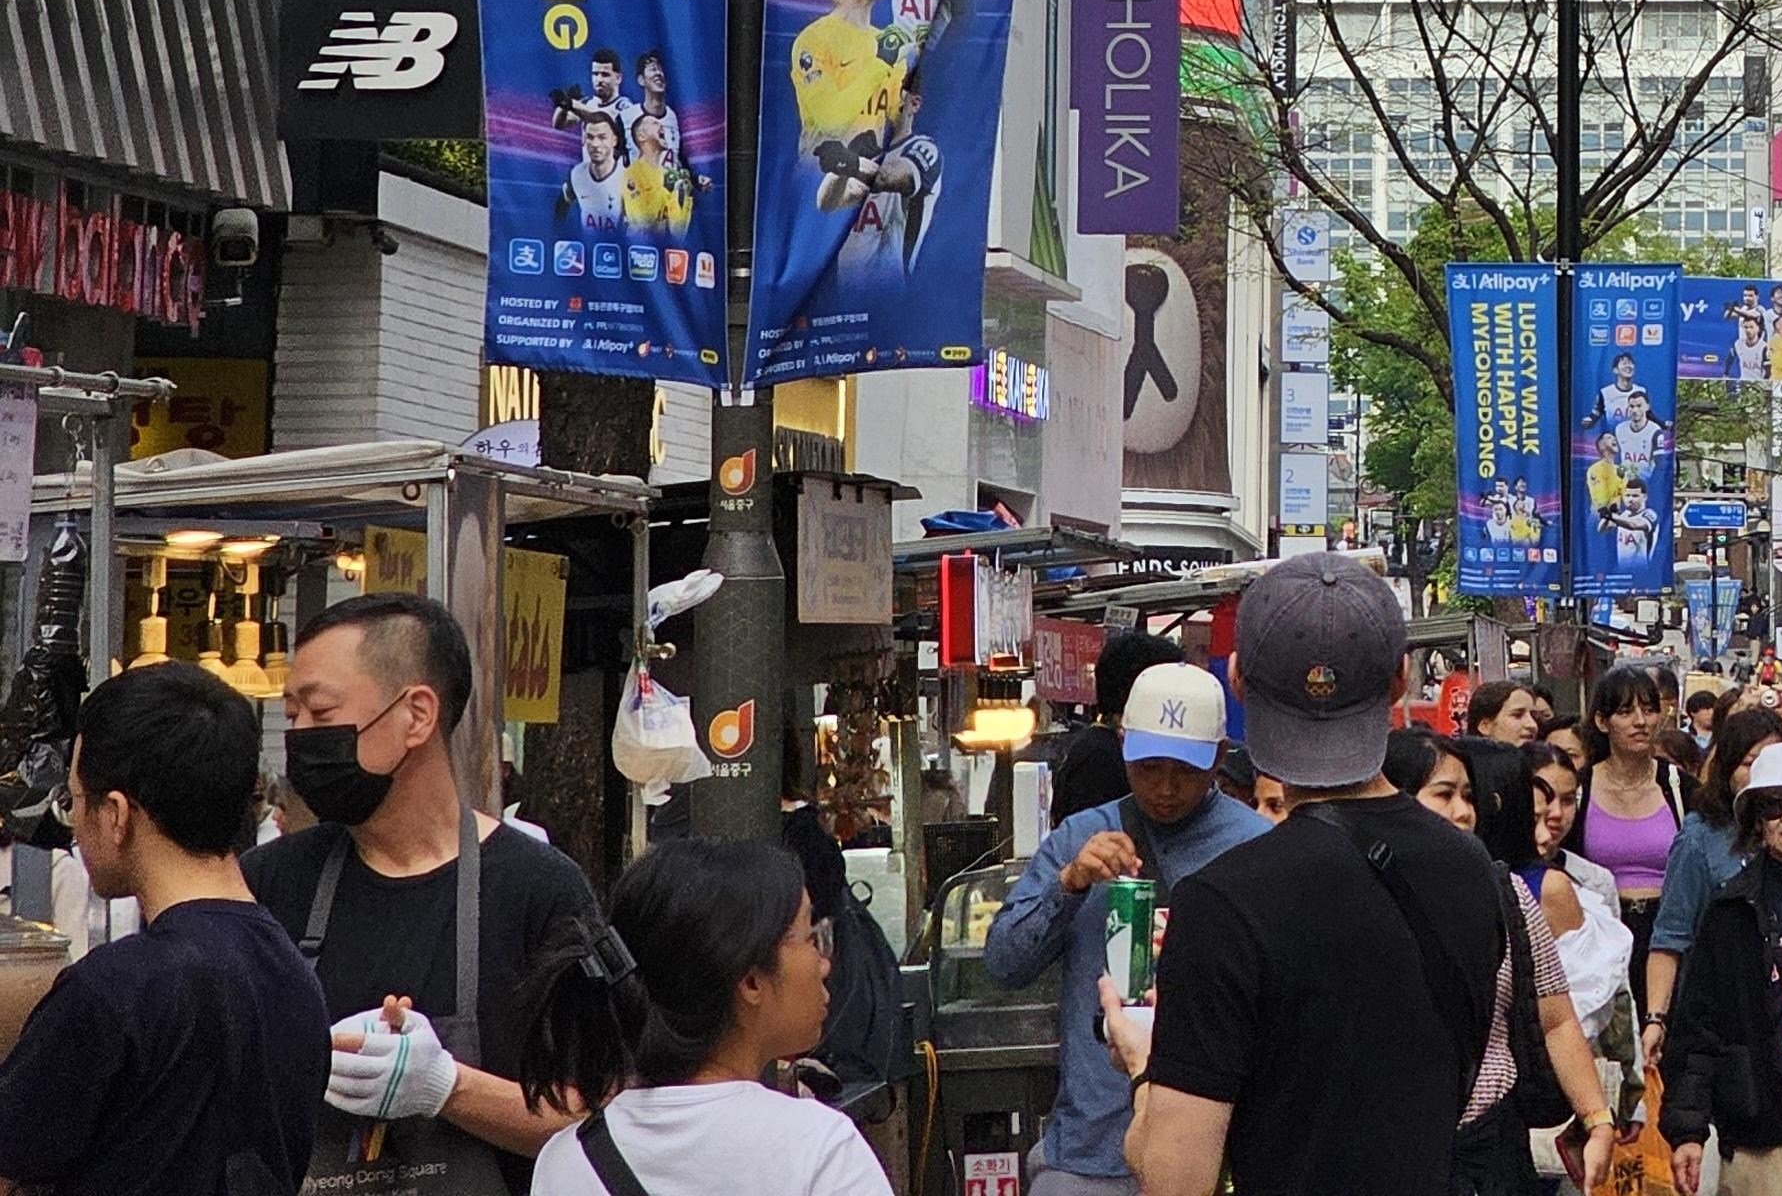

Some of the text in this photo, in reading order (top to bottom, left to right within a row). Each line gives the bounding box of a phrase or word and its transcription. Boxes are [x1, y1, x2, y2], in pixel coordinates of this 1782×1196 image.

[1274, 3, 1287, 92] TONYMOLY
[1478, 273, 1550, 293] Alipay+
[1605, 271, 1678, 292] Alipay+
[501, 296, 559, 310] HOSTED BY
[498, 316, 560, 329] ORGANIZED
[562, 319, 576, 330] BY
[496, 334, 557, 348] SUPPORTED
[559, 338, 573, 349] BY
[1493, 302, 1518, 451] WITH HAPPY
[1517, 303, 1541, 455] LUCKY WALK
[1286, 388, 1296, 403] 3
[1470, 303, 1497, 479] MYEONGDONG
[1623, 452, 1649, 463] AIA
[1285, 468, 1295, 484] 2
[1160, 698, 1187, 729] NY
[356, 1169, 395, 1184] Dong
[399, 1162, 447, 1180] Square
[972, 1158, 1011, 1177] 소화기
